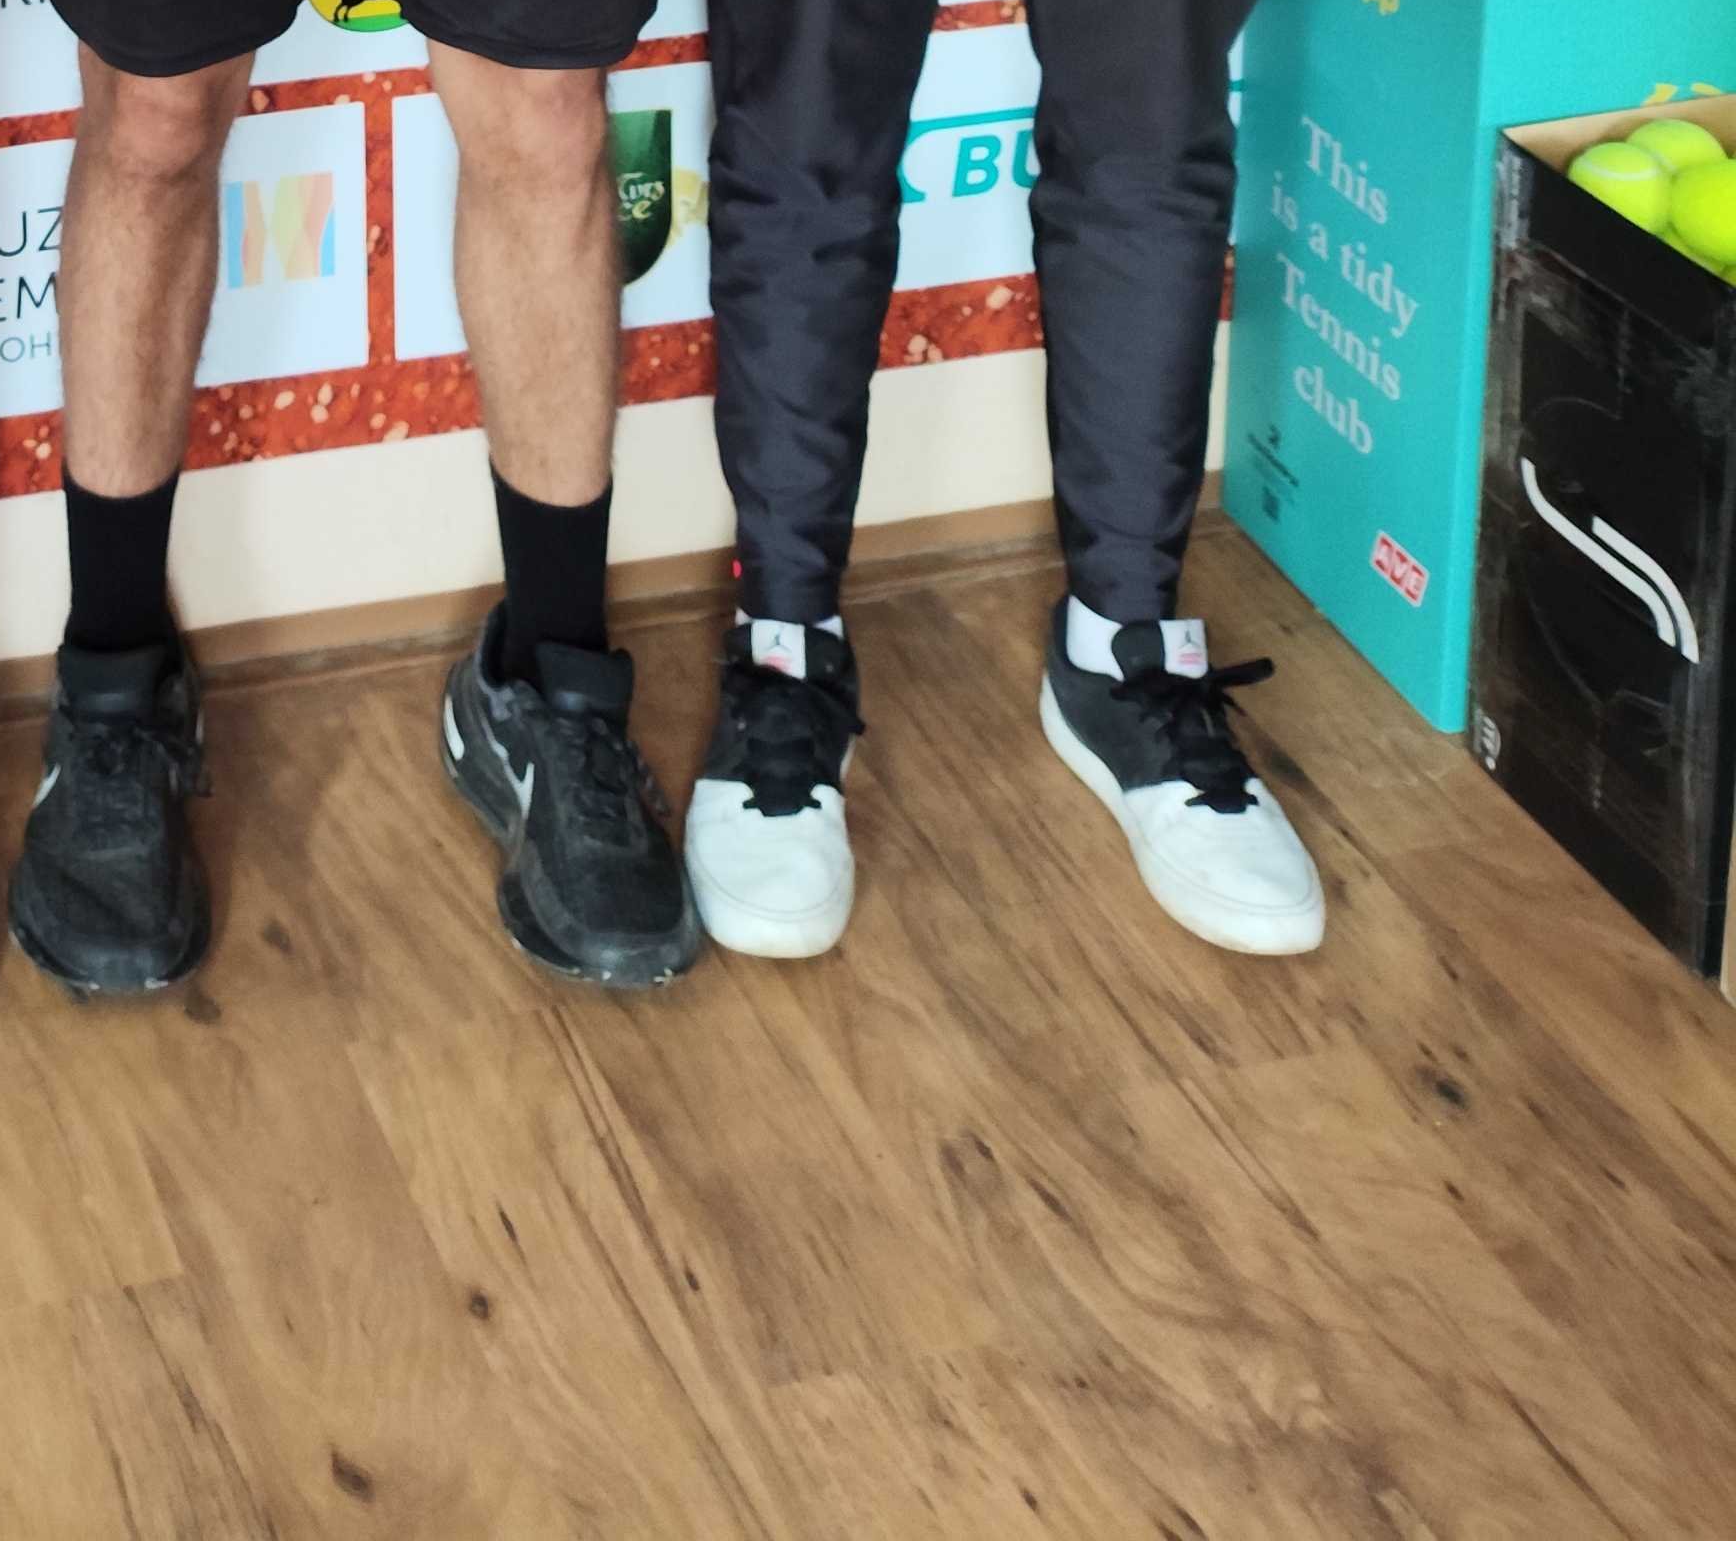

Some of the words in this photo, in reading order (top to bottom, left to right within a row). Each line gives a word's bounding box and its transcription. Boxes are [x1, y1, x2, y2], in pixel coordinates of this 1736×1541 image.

[1301, 114, 1388, 225] This
[1270, 170, 1299, 232] is
[1308, 221, 1329, 262] a
[1340, 241, 1420, 339] tidy
[1276, 251, 1402, 402] Tennis
[1292, 365, 1374, 455] club
